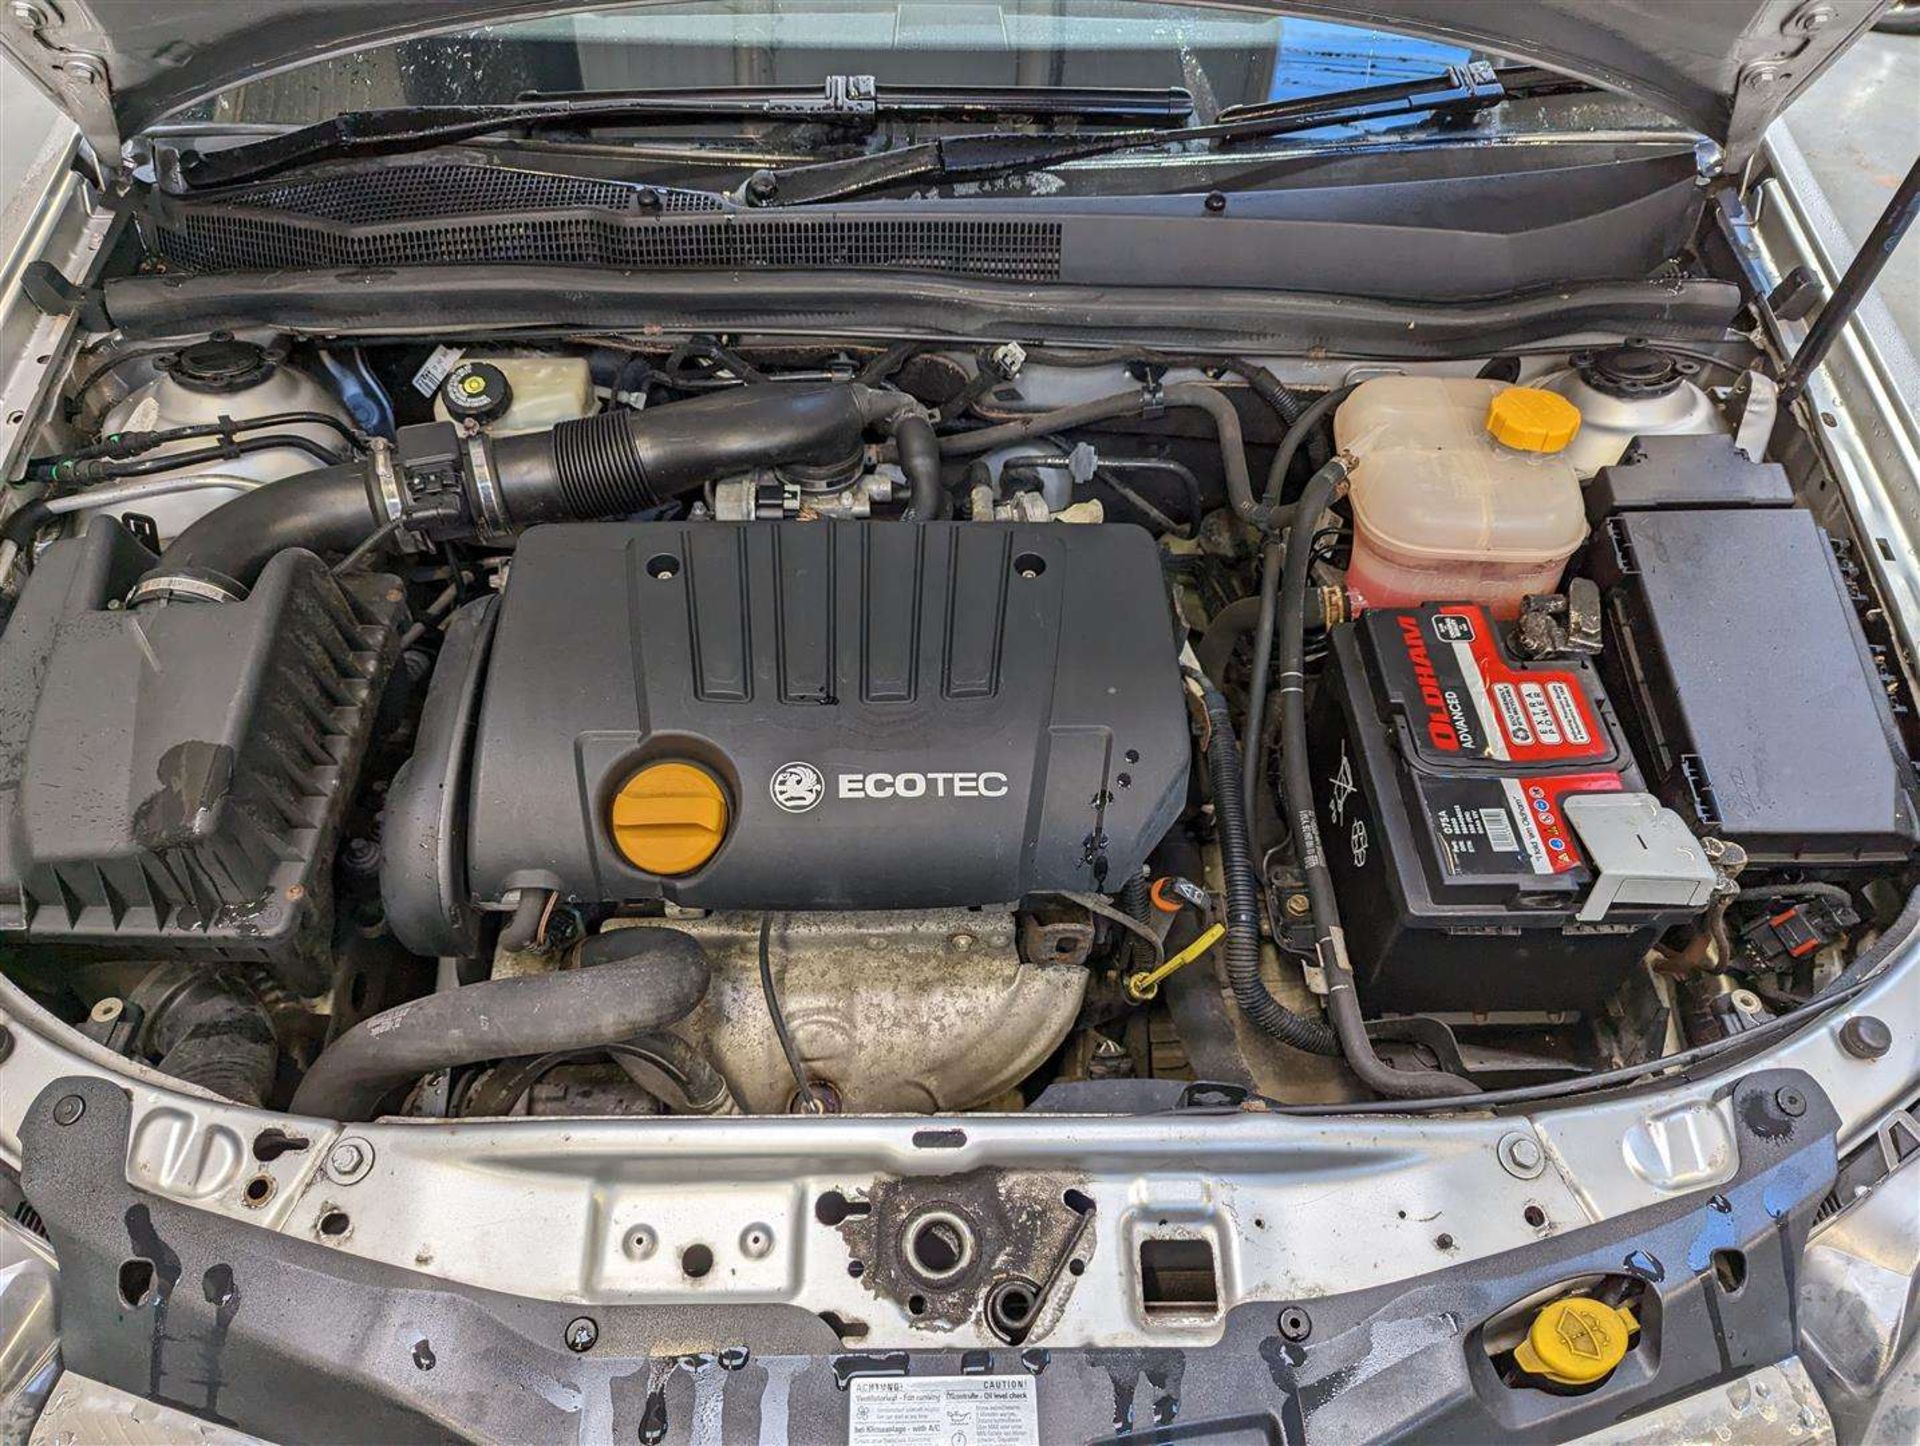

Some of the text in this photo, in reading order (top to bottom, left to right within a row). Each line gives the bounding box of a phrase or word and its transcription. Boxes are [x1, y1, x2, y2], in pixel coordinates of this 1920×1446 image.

[1397, 616, 1460, 750] OLDHAM
[1444, 691, 1476, 749] ADVANCED
[1525, 692, 1547, 734] EXTRA
[1533, 692, 1556, 734] POWER
[838, 772, 1008, 799] ECOTEC
[983, 1380, 1028, 1389] CAUTION!
